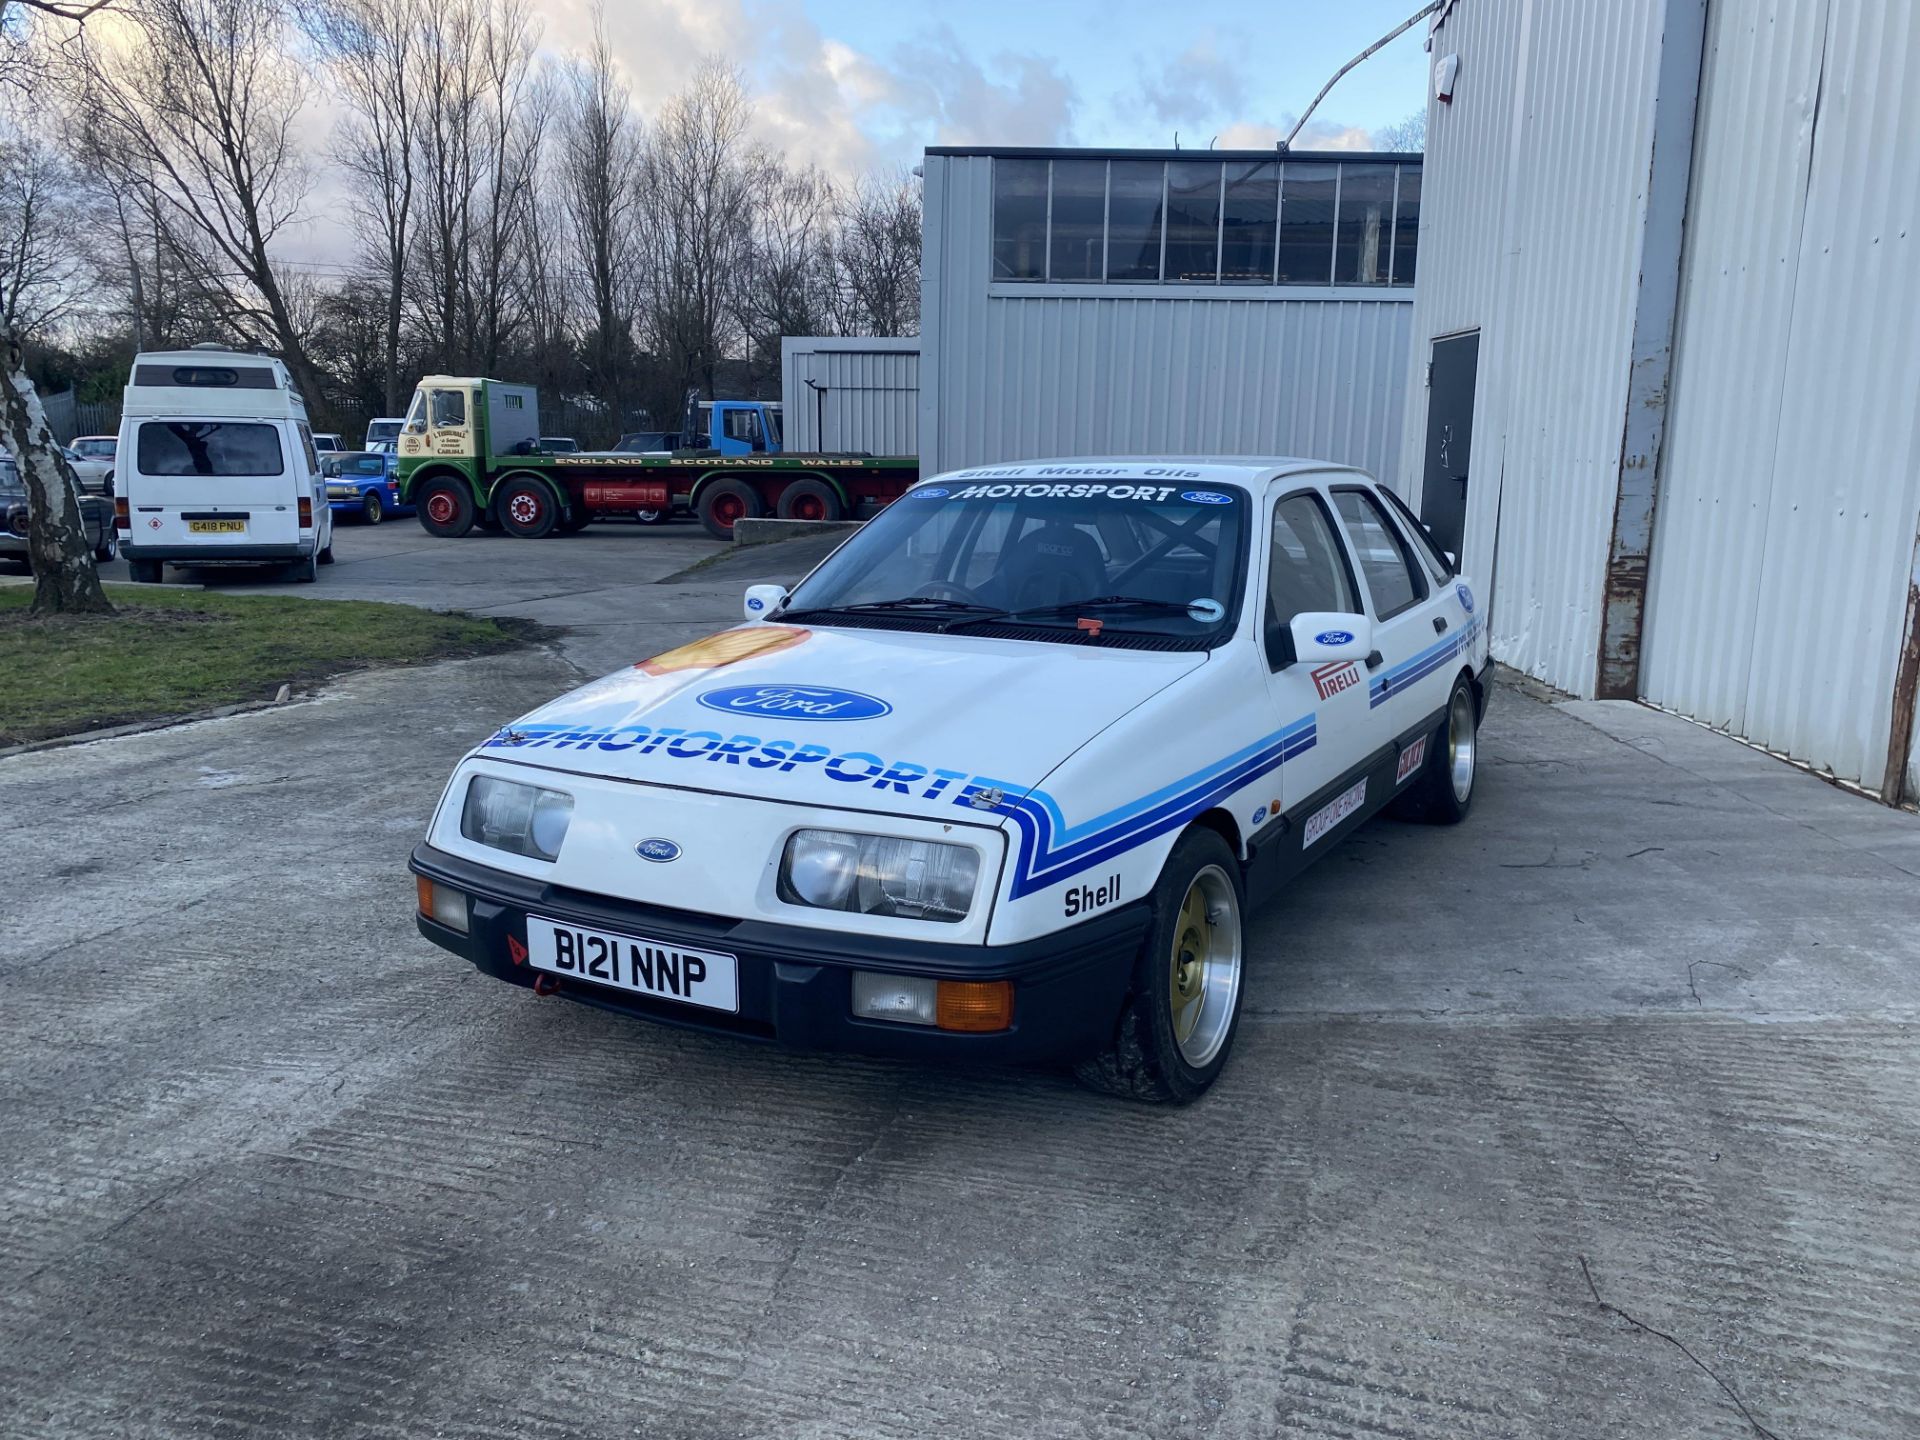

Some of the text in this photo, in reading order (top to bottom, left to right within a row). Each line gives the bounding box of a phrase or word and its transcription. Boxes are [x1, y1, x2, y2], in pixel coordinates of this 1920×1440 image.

[670, 458, 774, 466] SCOTLAND
[958, 467, 1201, 478] Shell Motor Oils
[949, 484, 1176, 502] MOTORSPORT
[192, 521, 241, 531] G418 PNU
[1310, 660, 1360, 701] PIRELLI
[729, 684, 853, 716] Ford
[529, 725, 968, 804] MOTORSPORT
[1065, 873, 1120, 917] Shell
[553, 927, 706, 998] B121 NNP
